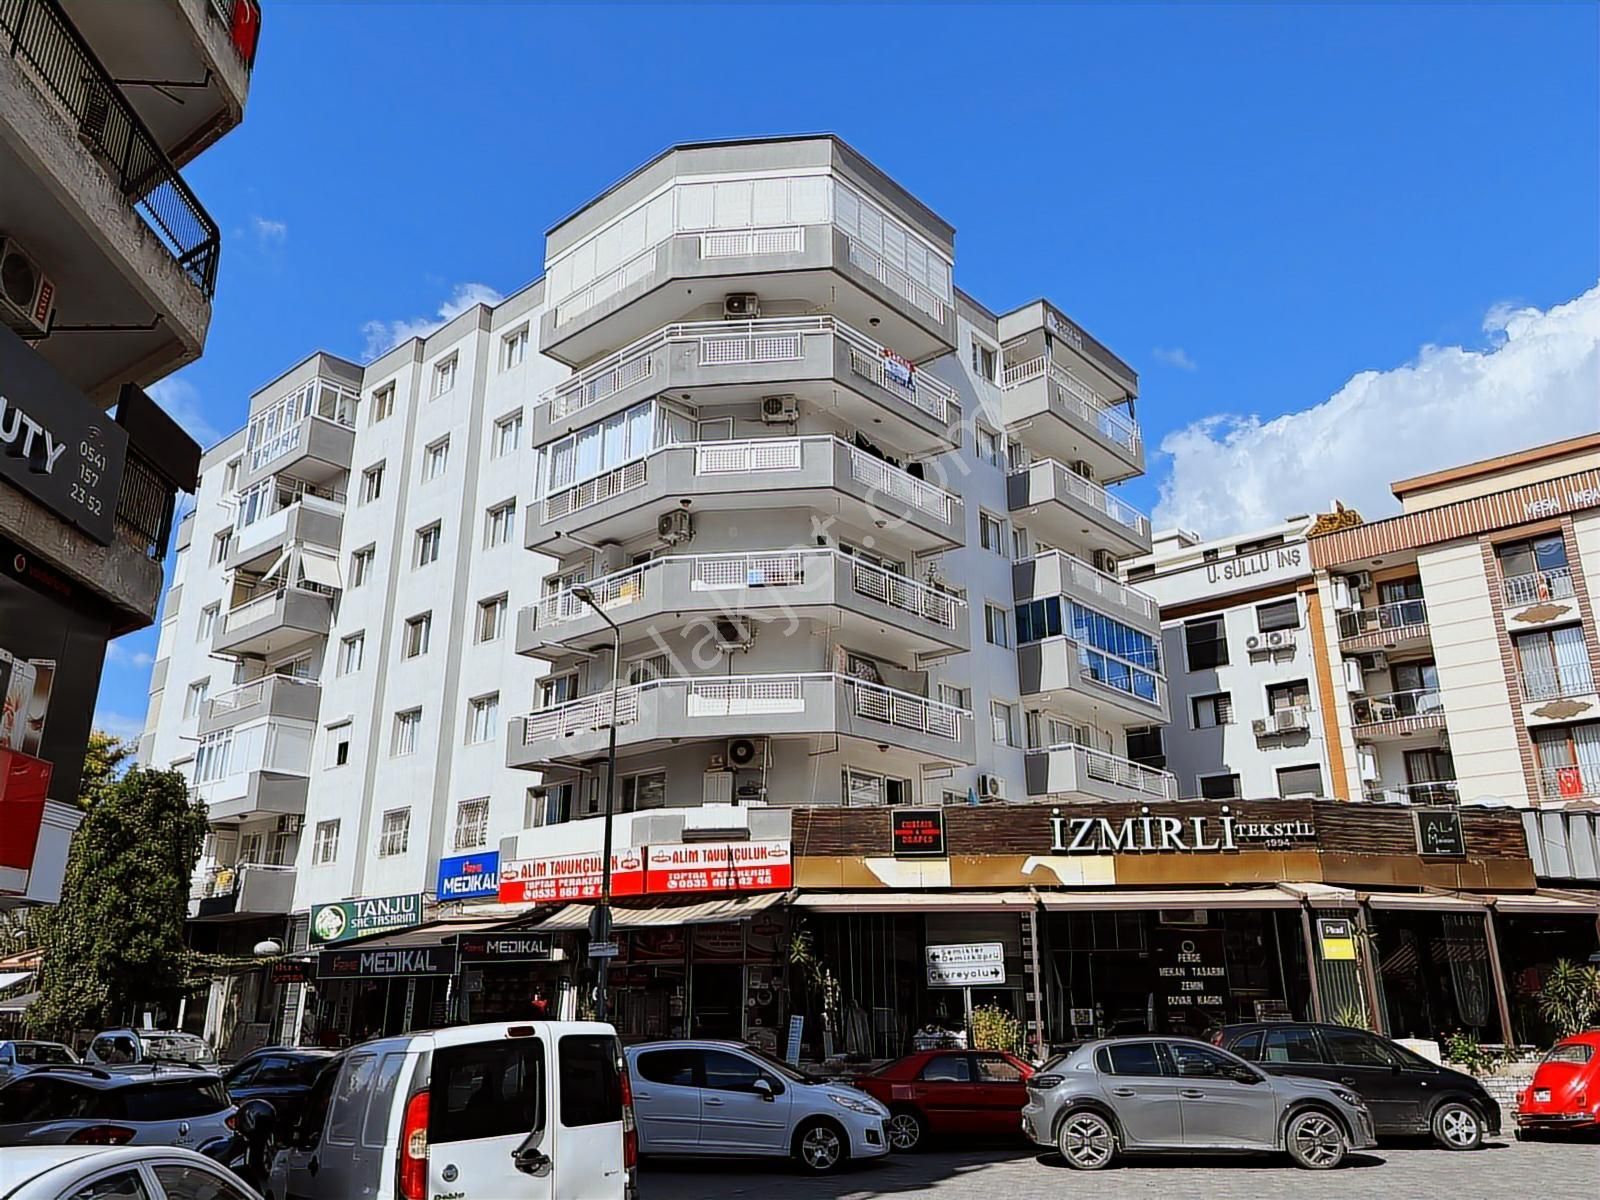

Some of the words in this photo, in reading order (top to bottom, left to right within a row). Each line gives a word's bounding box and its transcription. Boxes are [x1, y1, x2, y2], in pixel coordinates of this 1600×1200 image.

[80, 441, 106, 471] 0541
[80, 464, 99, 488] 157
[70, 483, 86, 504] 23
[87, 495, 102, 516] 52
[1050, 805, 1239, 851] İZMİRLİ
[1234, 820, 1315, 837] TEKSTİL
[1266, 838, 1290, 847] 1994
[520, 859, 547, 880] ALİM
[550, 855, 619, 878] TAVUKÇULK
[672, 848, 699, 865] ALİM
[353, 895, 415, 919] TANJU
